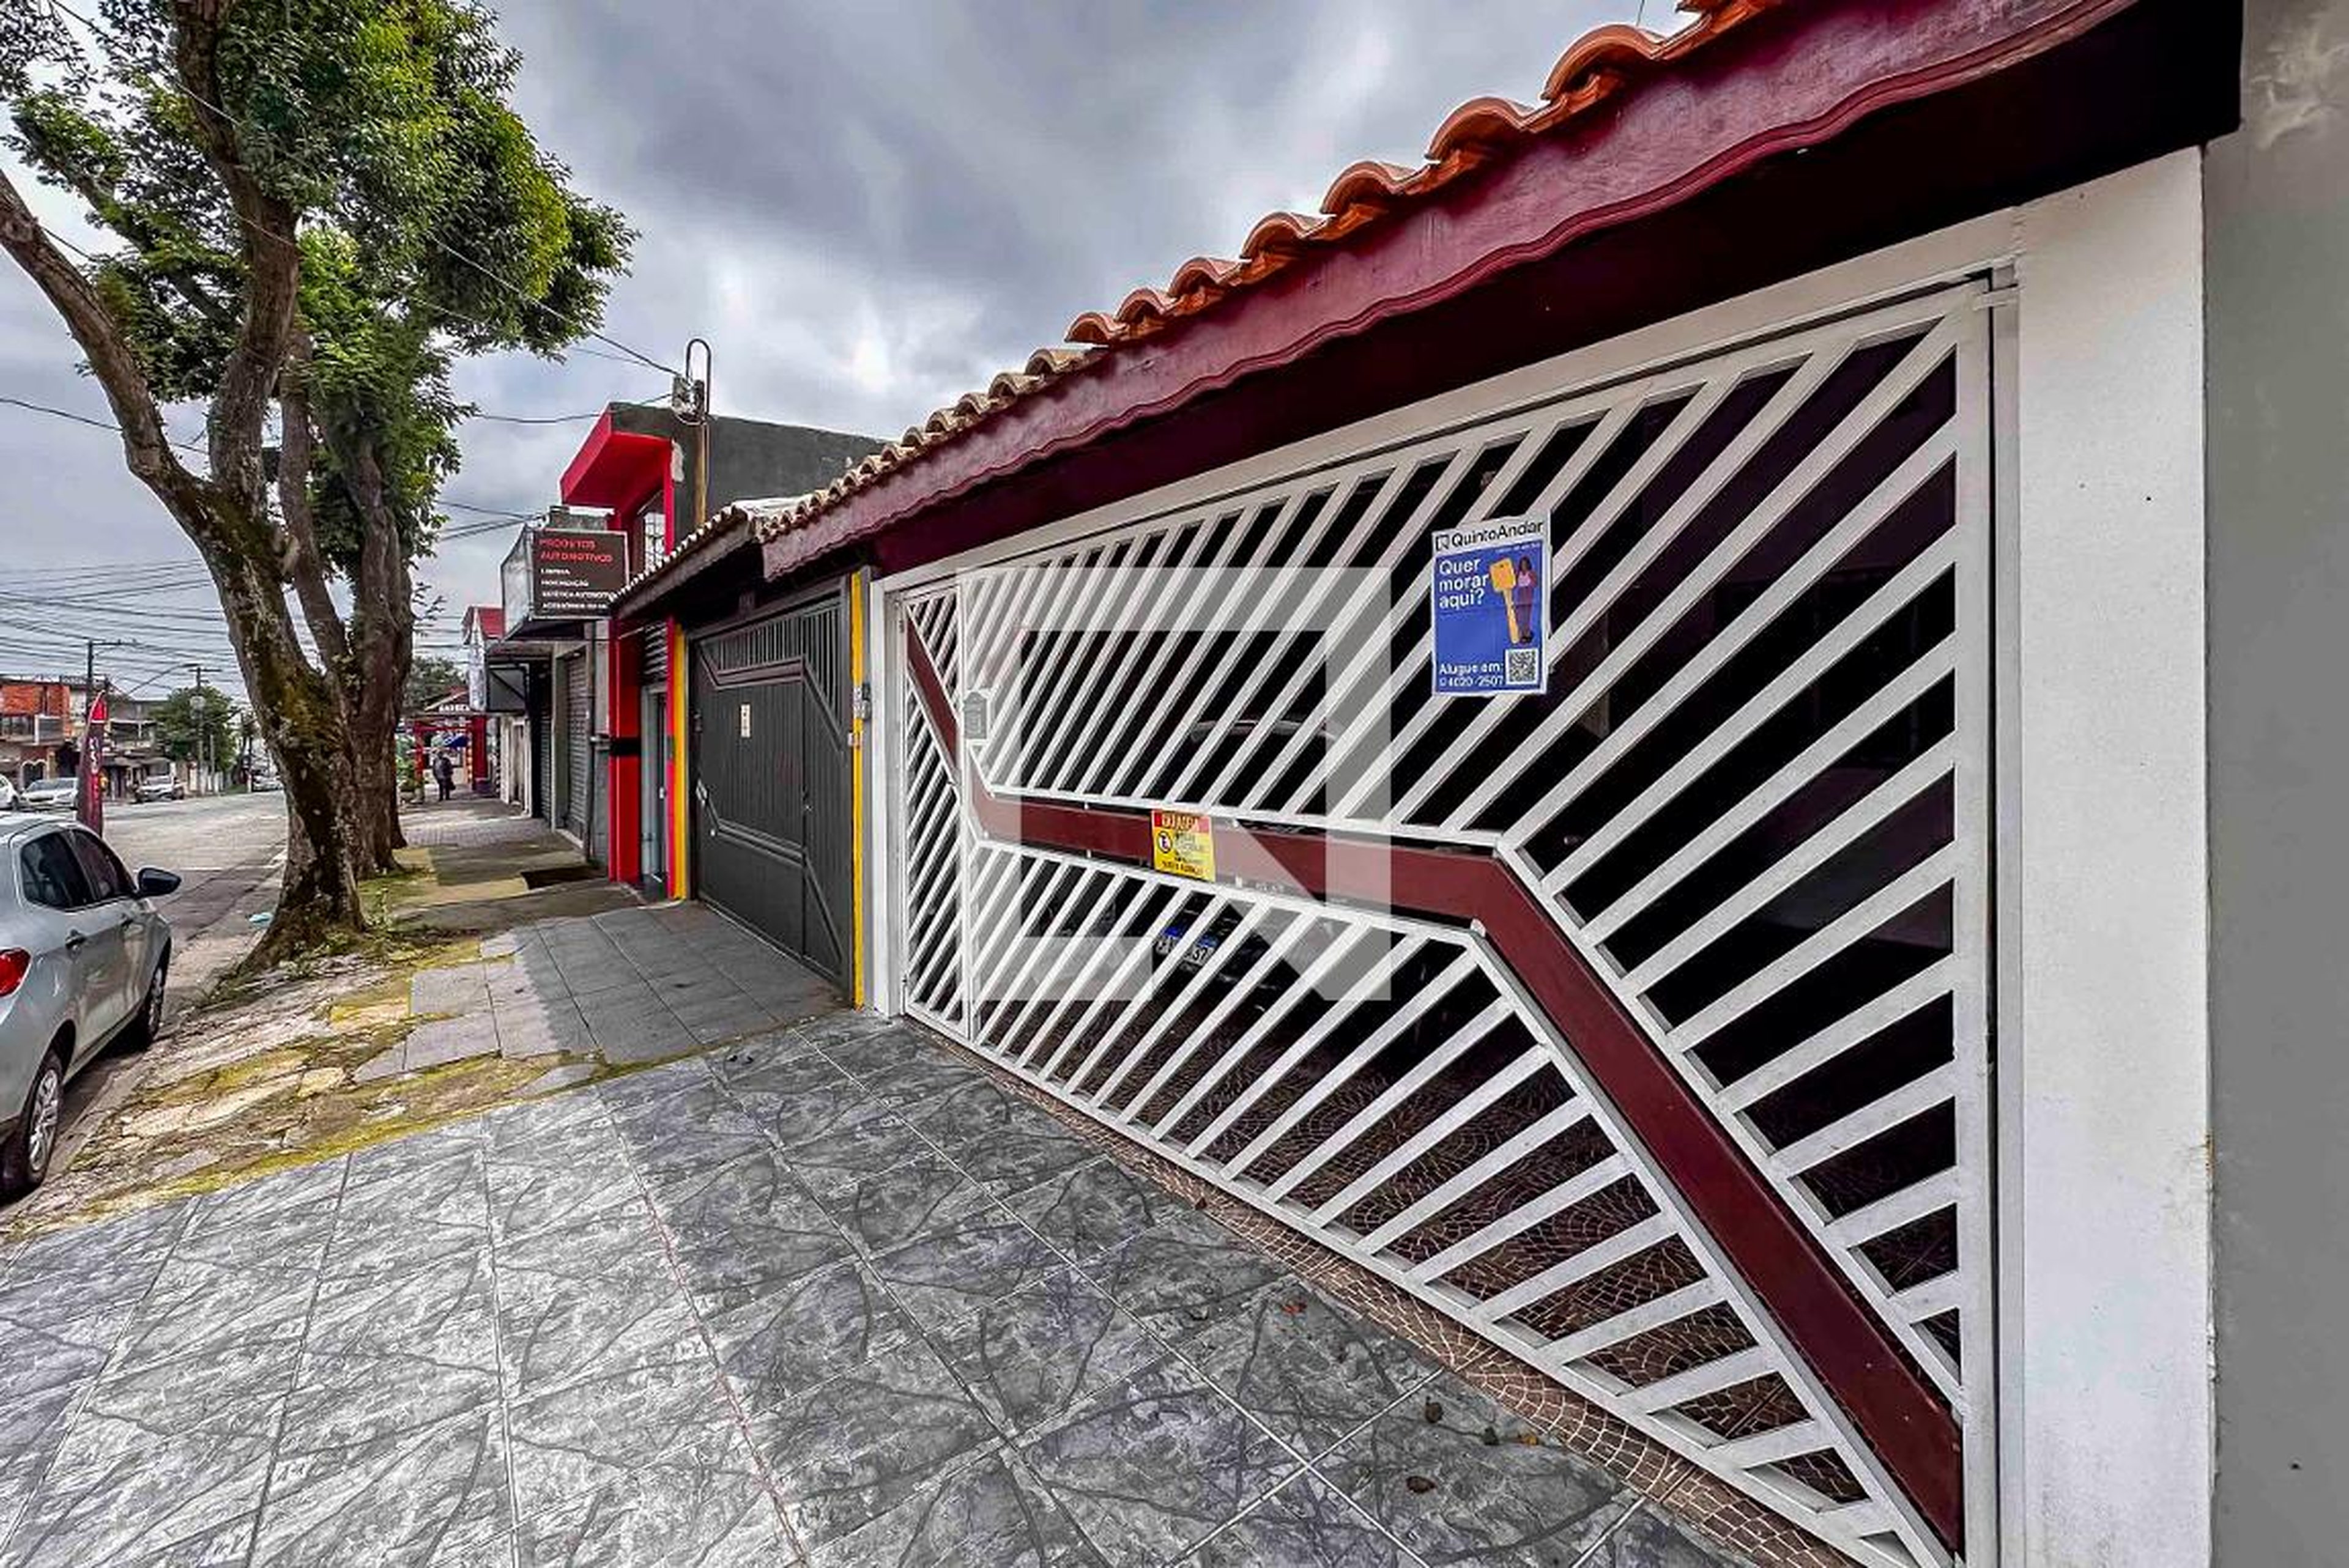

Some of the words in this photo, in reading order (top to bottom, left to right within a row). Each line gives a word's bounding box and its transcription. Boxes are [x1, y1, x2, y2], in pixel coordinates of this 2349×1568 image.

[1452, 521, 1543, 547] QuintoAndar
[539, 538, 595, 550] PRODUTOS
[540, 550, 614, 563] AUTOMOTIVOS
[1439, 559, 1481, 575] Quer
[1439, 574, 1490, 593] morar
[1439, 588, 1485, 610] aqui?
